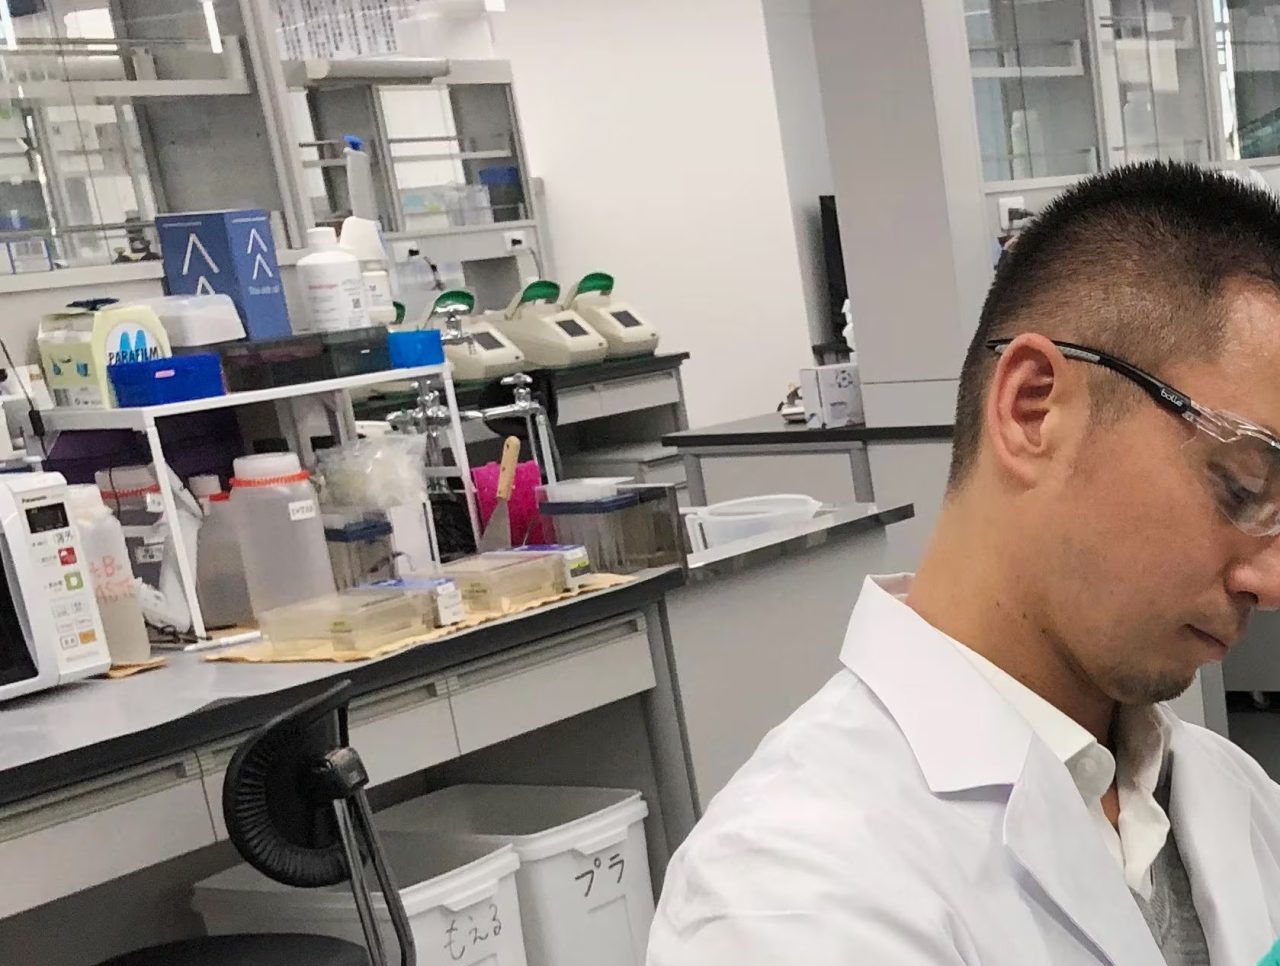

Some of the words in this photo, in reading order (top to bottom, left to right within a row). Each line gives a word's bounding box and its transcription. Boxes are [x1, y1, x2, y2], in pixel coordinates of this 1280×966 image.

[108, 346, 159, 366] PARAFILM
[574, 852, 626, 898] プラ
[443, 902, 502, 961] もえる
